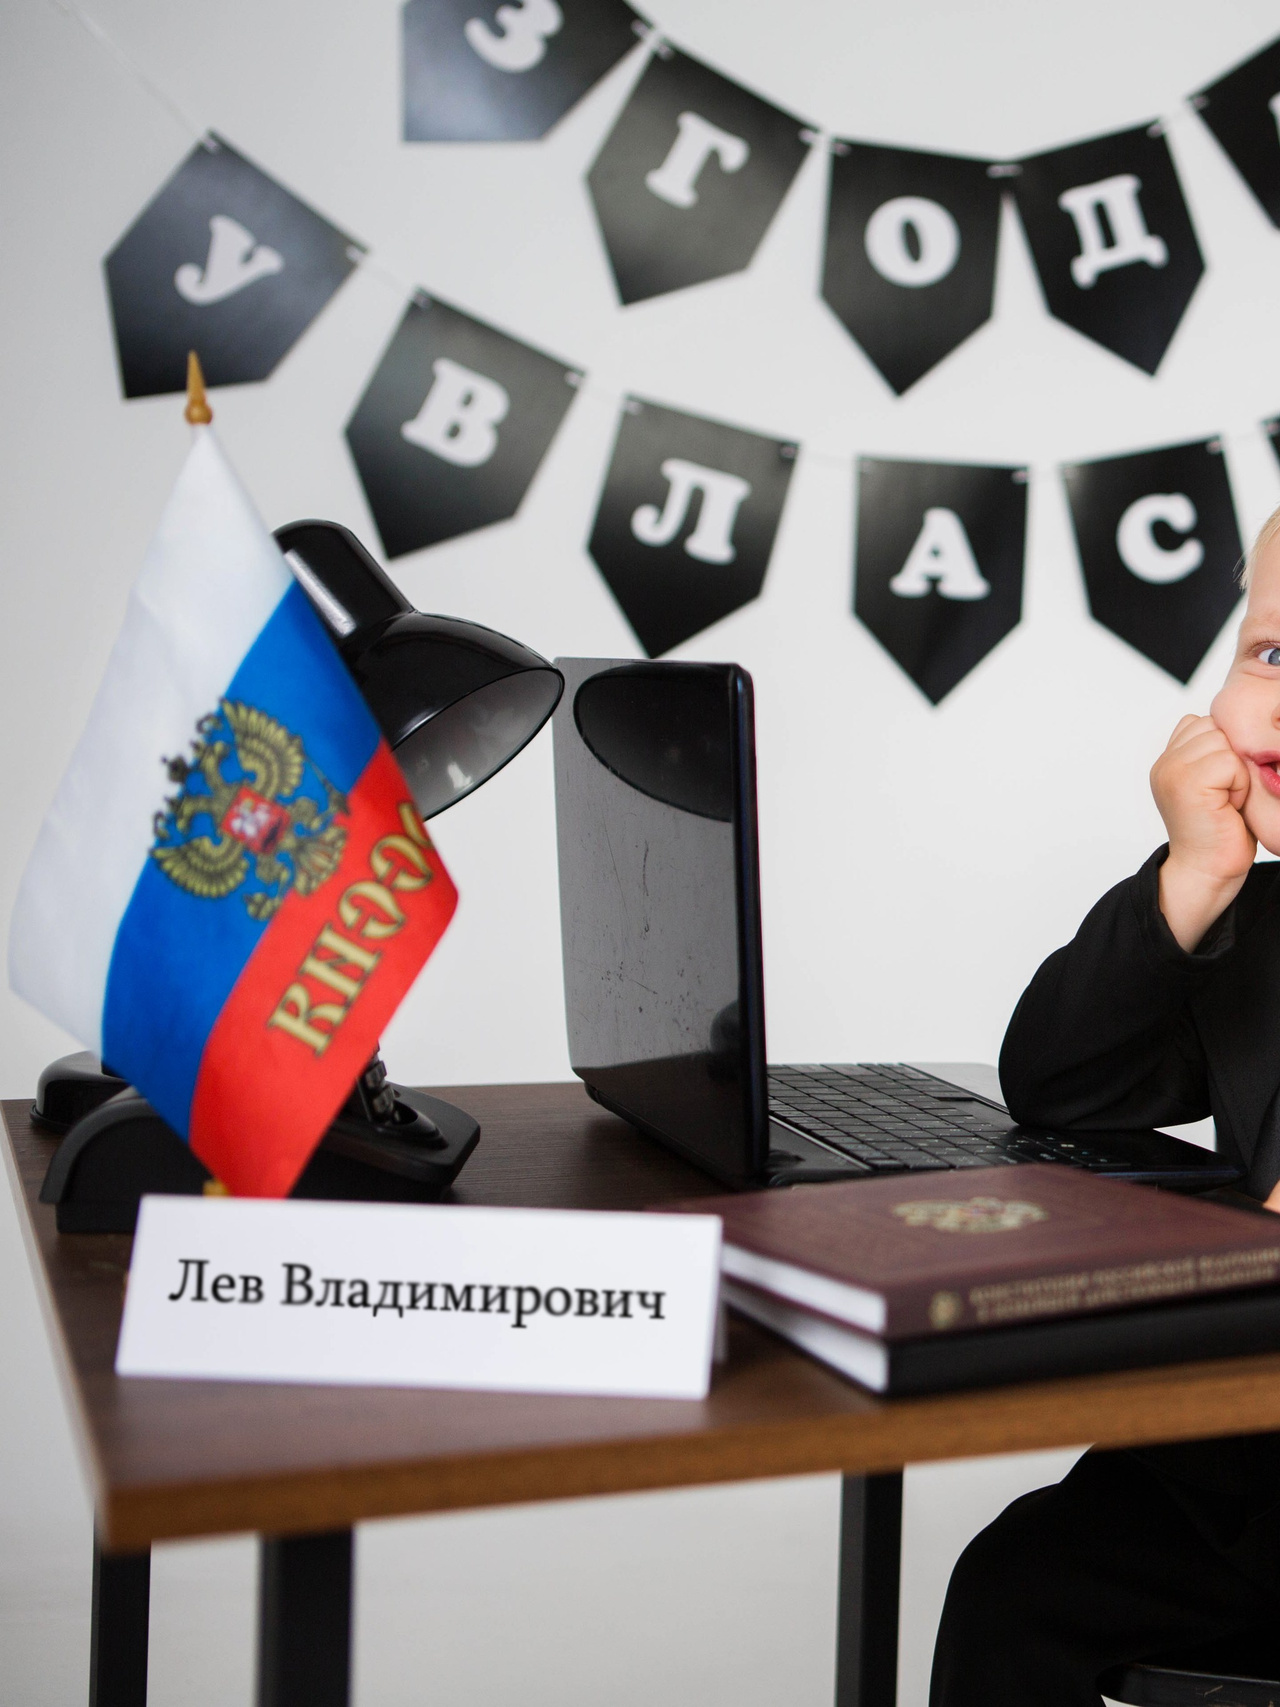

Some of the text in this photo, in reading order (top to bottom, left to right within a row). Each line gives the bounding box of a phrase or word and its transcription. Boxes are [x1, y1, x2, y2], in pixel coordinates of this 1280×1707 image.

[176, 216, 285, 304] У
[168, 1258, 667, 1329] Лев Владимирович
